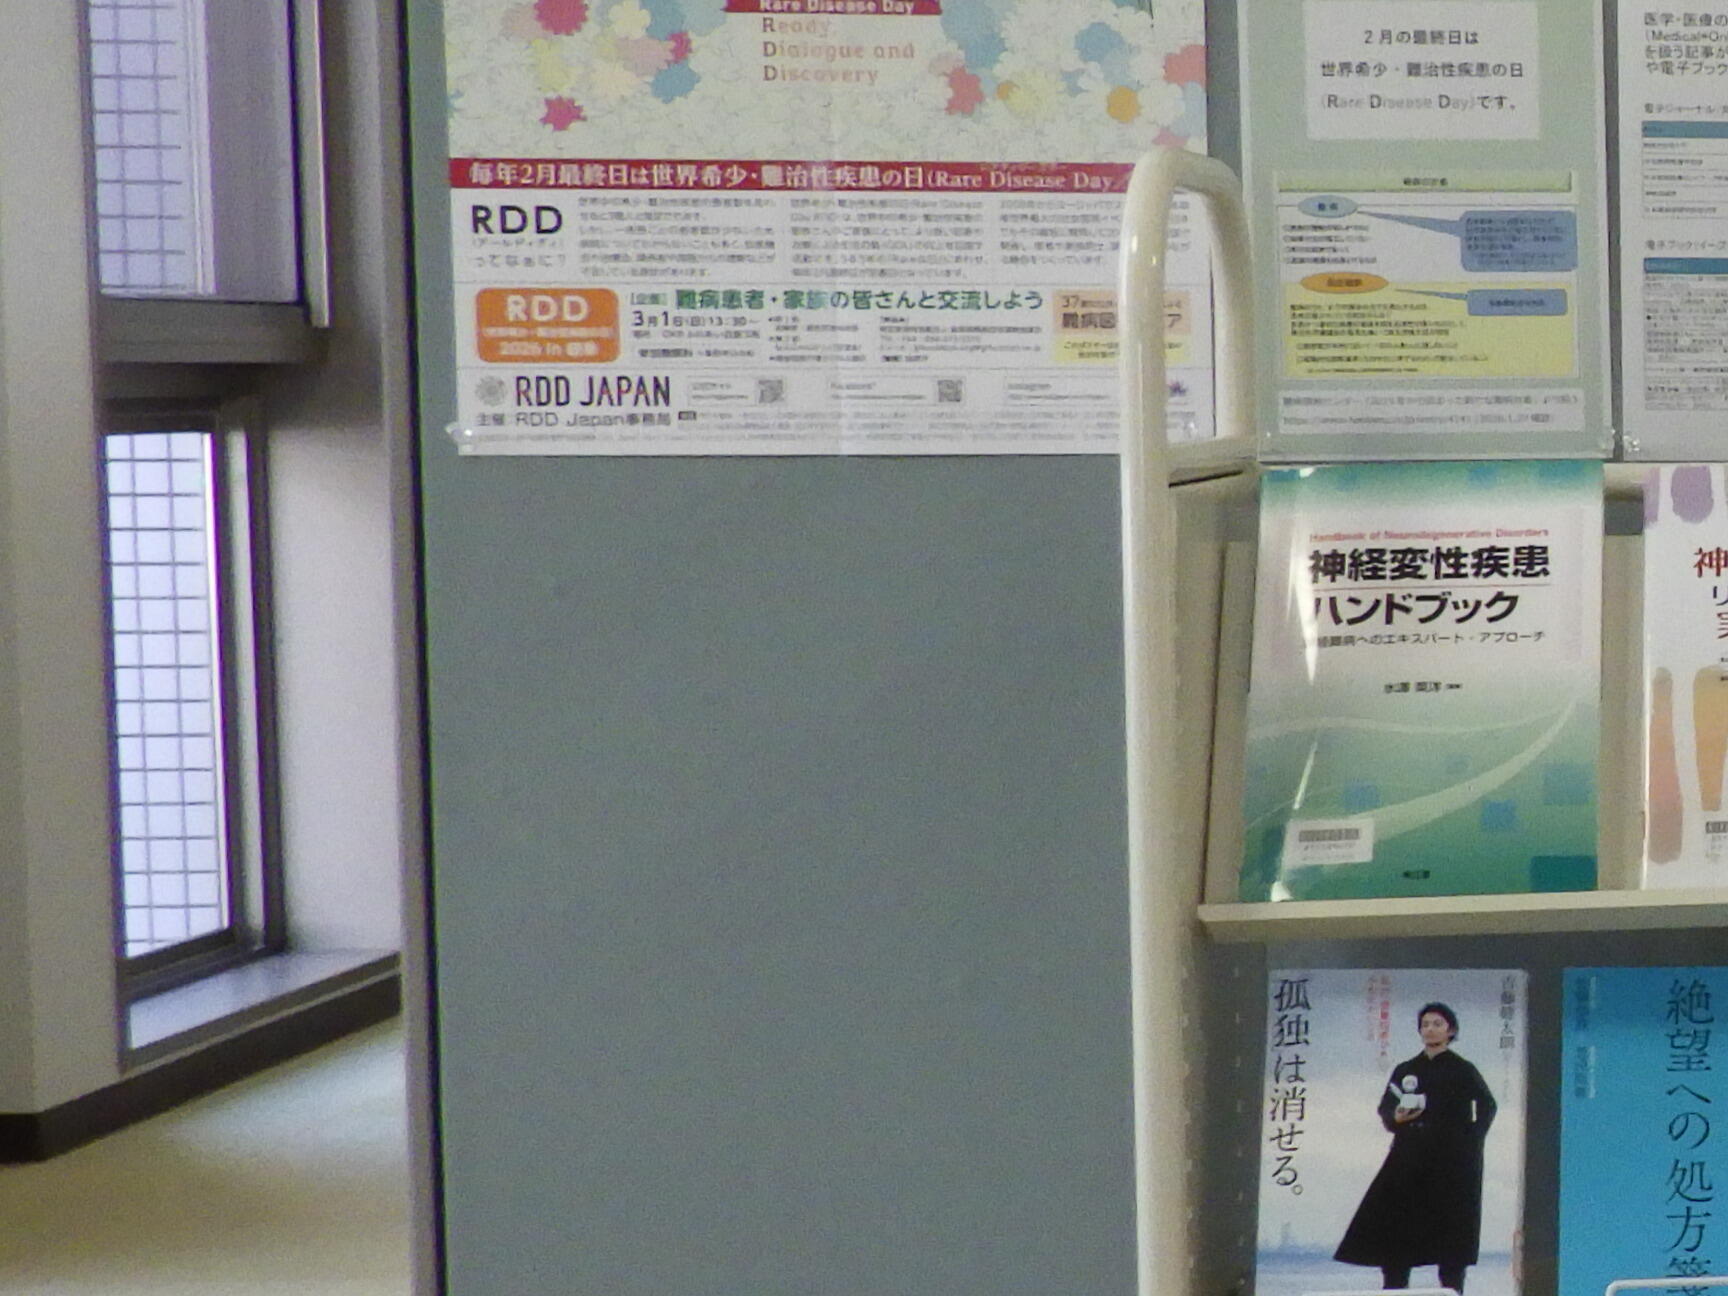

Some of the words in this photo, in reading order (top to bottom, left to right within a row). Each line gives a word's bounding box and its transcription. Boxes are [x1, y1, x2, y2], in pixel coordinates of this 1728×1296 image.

[763, 41, 864, 62] Dialogue
[873, 43, 915, 58] and
[763, 65, 879, 85] Discovery
[990, 169, 1066, 189] Disease
[471, 204, 564, 235] RDD
[505, 295, 591, 322] RDD
[515, 375, 570, 406] RDD
[579, 375, 671, 406] JAPAN
[515, 411, 559, 426] RDD
[1369, 531, 1382, 541] of
[1309, 544, 1551, 584] 神経変性疾患
[1314, 590, 1520, 627] ハンドブック
[1268, 976, 1311, 1197] 孤独は消せる。
